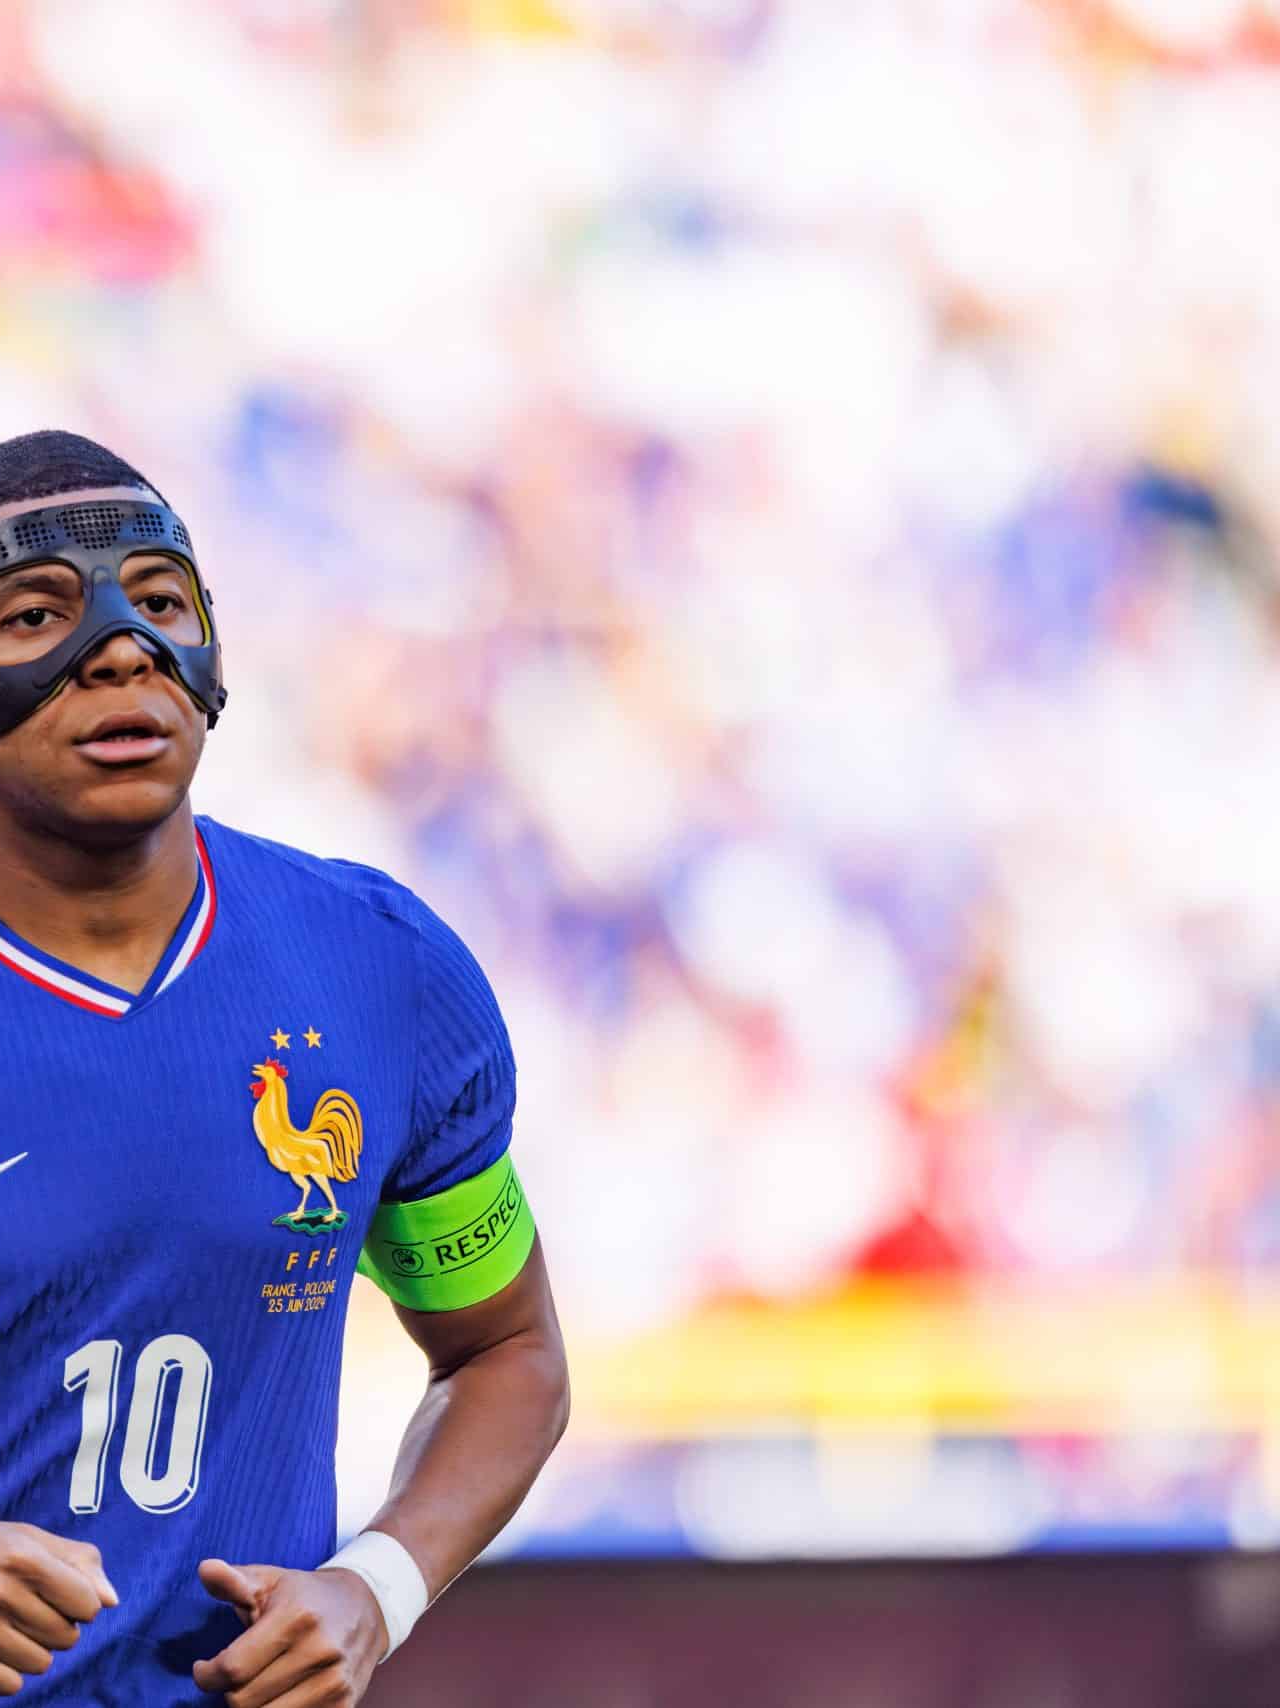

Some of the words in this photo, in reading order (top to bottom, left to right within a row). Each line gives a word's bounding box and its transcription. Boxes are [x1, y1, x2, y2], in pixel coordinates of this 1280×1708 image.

[262, 1284, 297, 1297] FRANCE
[267, 1298, 283, 1313] 25
[286, 1298, 304, 1313] JUIN
[304, 1296, 326, 1311] 2024
[63, 1333, 213, 1515] 10
